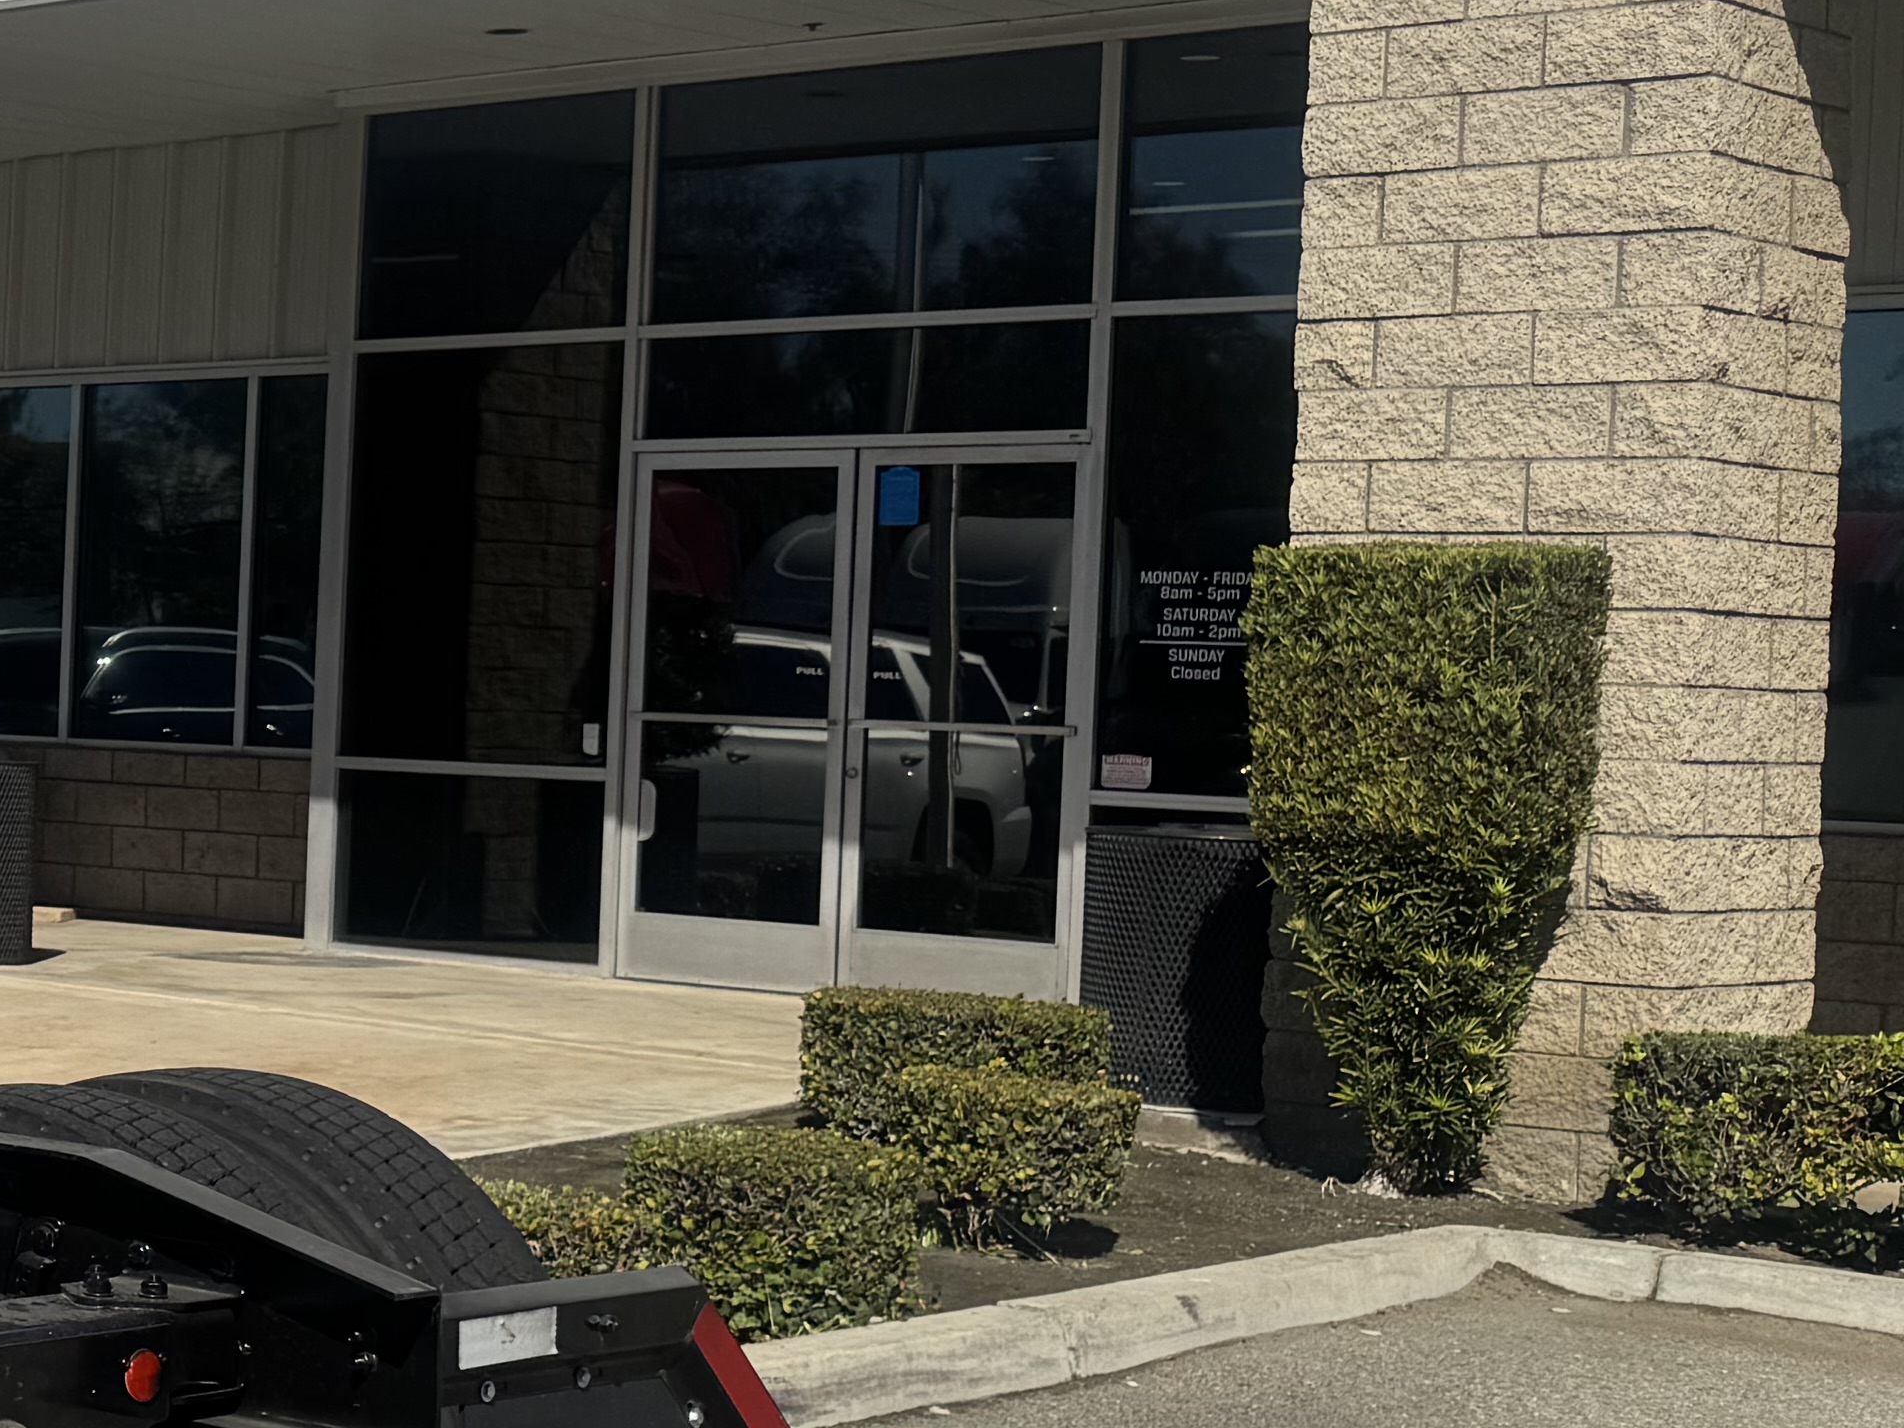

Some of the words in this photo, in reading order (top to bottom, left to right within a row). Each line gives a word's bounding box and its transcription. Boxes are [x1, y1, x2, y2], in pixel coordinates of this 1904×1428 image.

[1140, 571, 1199, 584] MONDAY
[1213, 571, 1253, 585] FRIDA
[1160, 586, 1192, 599] 8am
[1207, 587, 1240, 602] 5pm
[1163, 607, 1236, 622] SATURDAY
[1156, 623, 1195, 637] 10am
[1208, 625, 1241, 640] 2pm
[1168, 649, 1225, 663] SUNDAY
[796, 666, 824, 676] PULL
[873, 671, 901, 680] PULL
[1171, 666, 1221, 680] Closed
